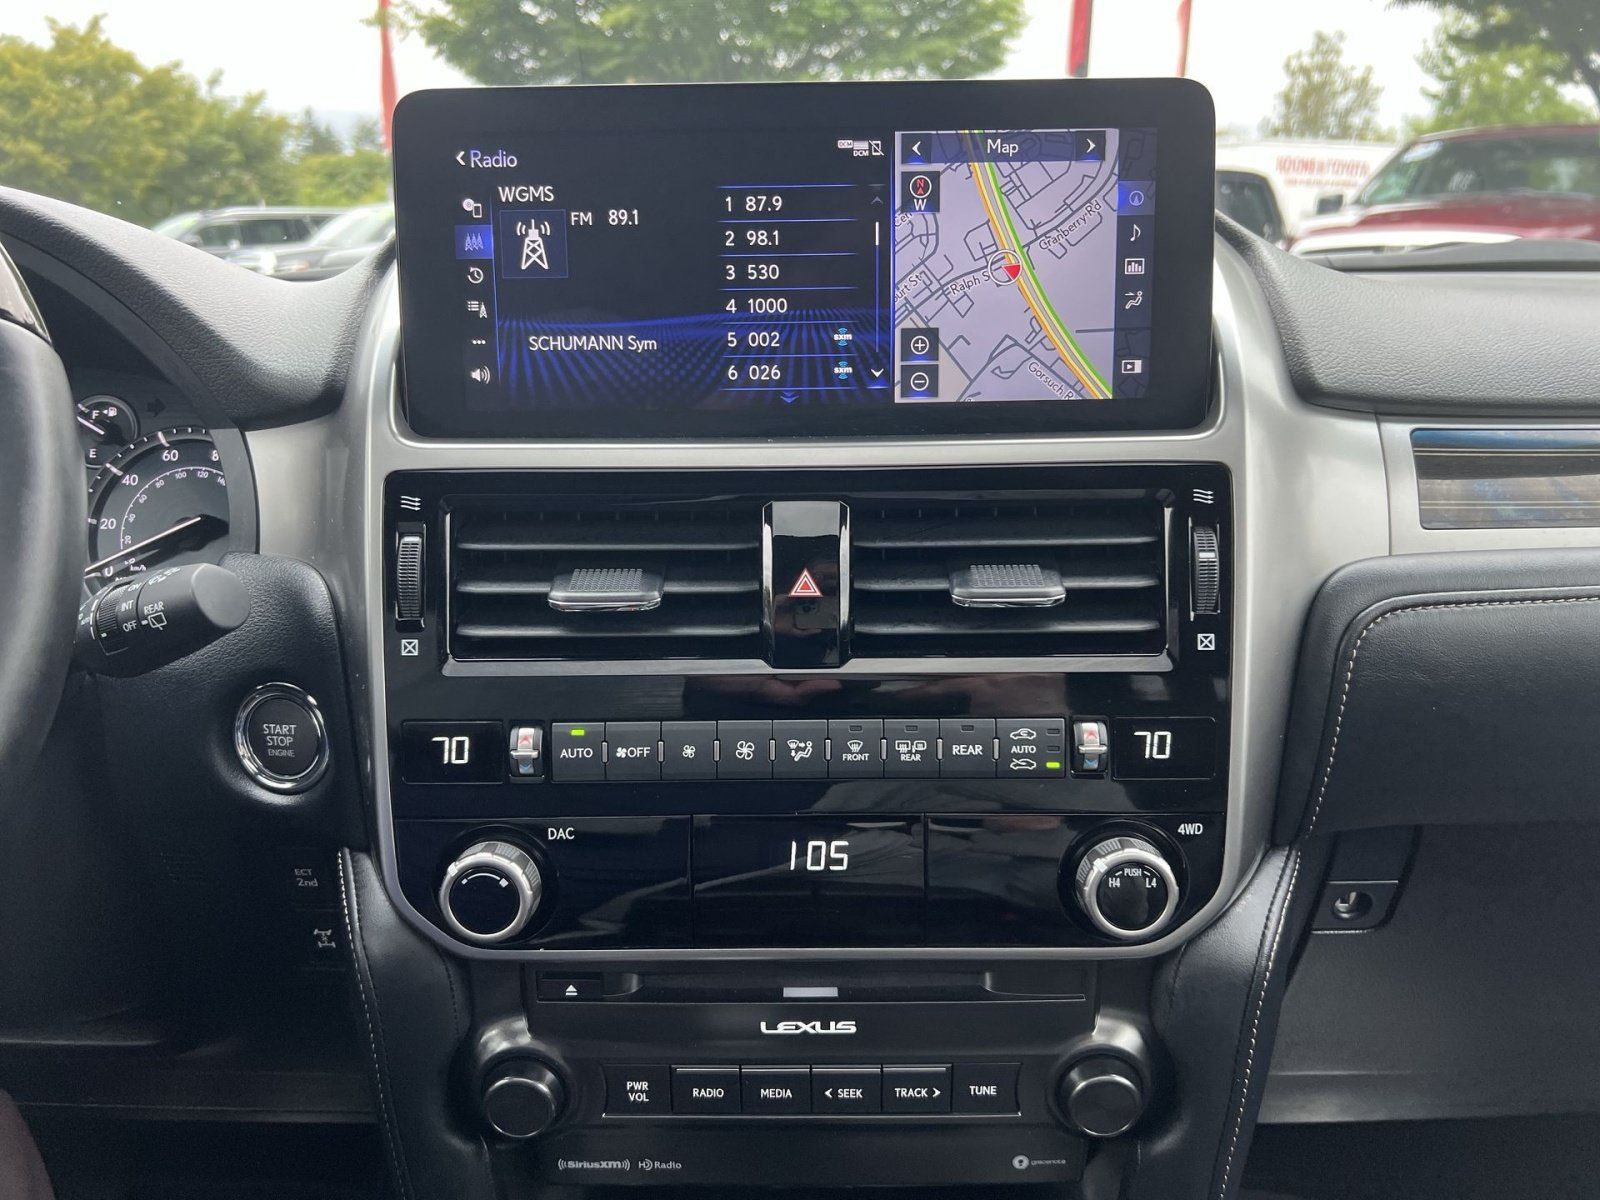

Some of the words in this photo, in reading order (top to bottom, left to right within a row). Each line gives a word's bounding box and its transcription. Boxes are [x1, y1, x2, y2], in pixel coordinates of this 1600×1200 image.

[987, 139, 1019, 157] Map
[470, 150, 518, 169] Radio
[916, 178, 925, 188] N
[498, 186, 555, 203] WGMS
[725, 196, 733, 212] 1
[745, 196, 783, 212] 87.9
[914, 199, 927, 211] W
[571, 212, 593, 226] FM
[608, 209, 640, 226] 89.1
[1039, 214, 1088, 251] Cranberry
[1086, 200, 1102, 217] Rd
[725, 231, 735, 247] 2
[746, 230, 780, 247] 98.1
[726, 265, 736, 280] 3
[747, 264, 780, 280] 530
[950, 275, 981, 295] Ralph
[725, 299, 738, 314] 4
[747, 298, 788, 314] 1000
[529, 335, 624, 352] SCHUMANN
[628, 335, 657, 353] Sym
[727, 332, 737, 348] 5
[748, 332, 781, 347] 002
[728, 365, 738, 380] 6
[748, 365, 781, 380] 026
[1029, 361, 1064, 396] Gorsuch
[92, 410, 100, 420] F
[89, 449, 97, 458] E
[162, 450, 179, 462] 60
[122, 474, 139, 486] 40
[175, 471, 187, 479] 100
[197, 470, 209, 479] 120
[155, 480, 165, 489] 80
[100, 518, 117, 530] 20
[121, 600, 134, 612] INT
[143, 601, 165, 615] REAR
[122, 620, 138, 632] OFF
[263, 723, 297, 736] START
[266, 736, 294, 747] STOP
[1133, 730, 1172, 760] 70
[267, 748, 296, 758] ENGINE
[431, 736, 469, 765] 70
[560, 748, 593, 759] AUTO
[627, 747, 651, 758] OFF
[952, 744, 983, 756] REAR
[1010, 745, 1037, 754] AUTO
[842, 753, 870, 762] FRONT
[900, 753, 922, 762] REAR
[547, 827, 575, 841] DAC
[1177, 823, 1203, 836] 4WD
[294, 868, 312, 877] ECT
[1124, 868, 1142, 877] PUSH
[296, 878, 318, 888] 2nd
[1108, 877, 1121, 888] H4
[1145, 877, 1157, 888] L4
[760, 1020, 858, 1035] LEXUS
[626, 1081, 649, 1091] PWR
[969, 1085, 997, 1096] TUNE
[628, 1092, 650, 1102] VOL
[692, 1087, 724, 1098] RADIO
[760, 1088, 793, 1099] MEDIA
[837, 1088, 863, 1099] SEEK
[894, 1087, 928, 1098] TRACK
[654, 1160, 682, 1169] Radio
